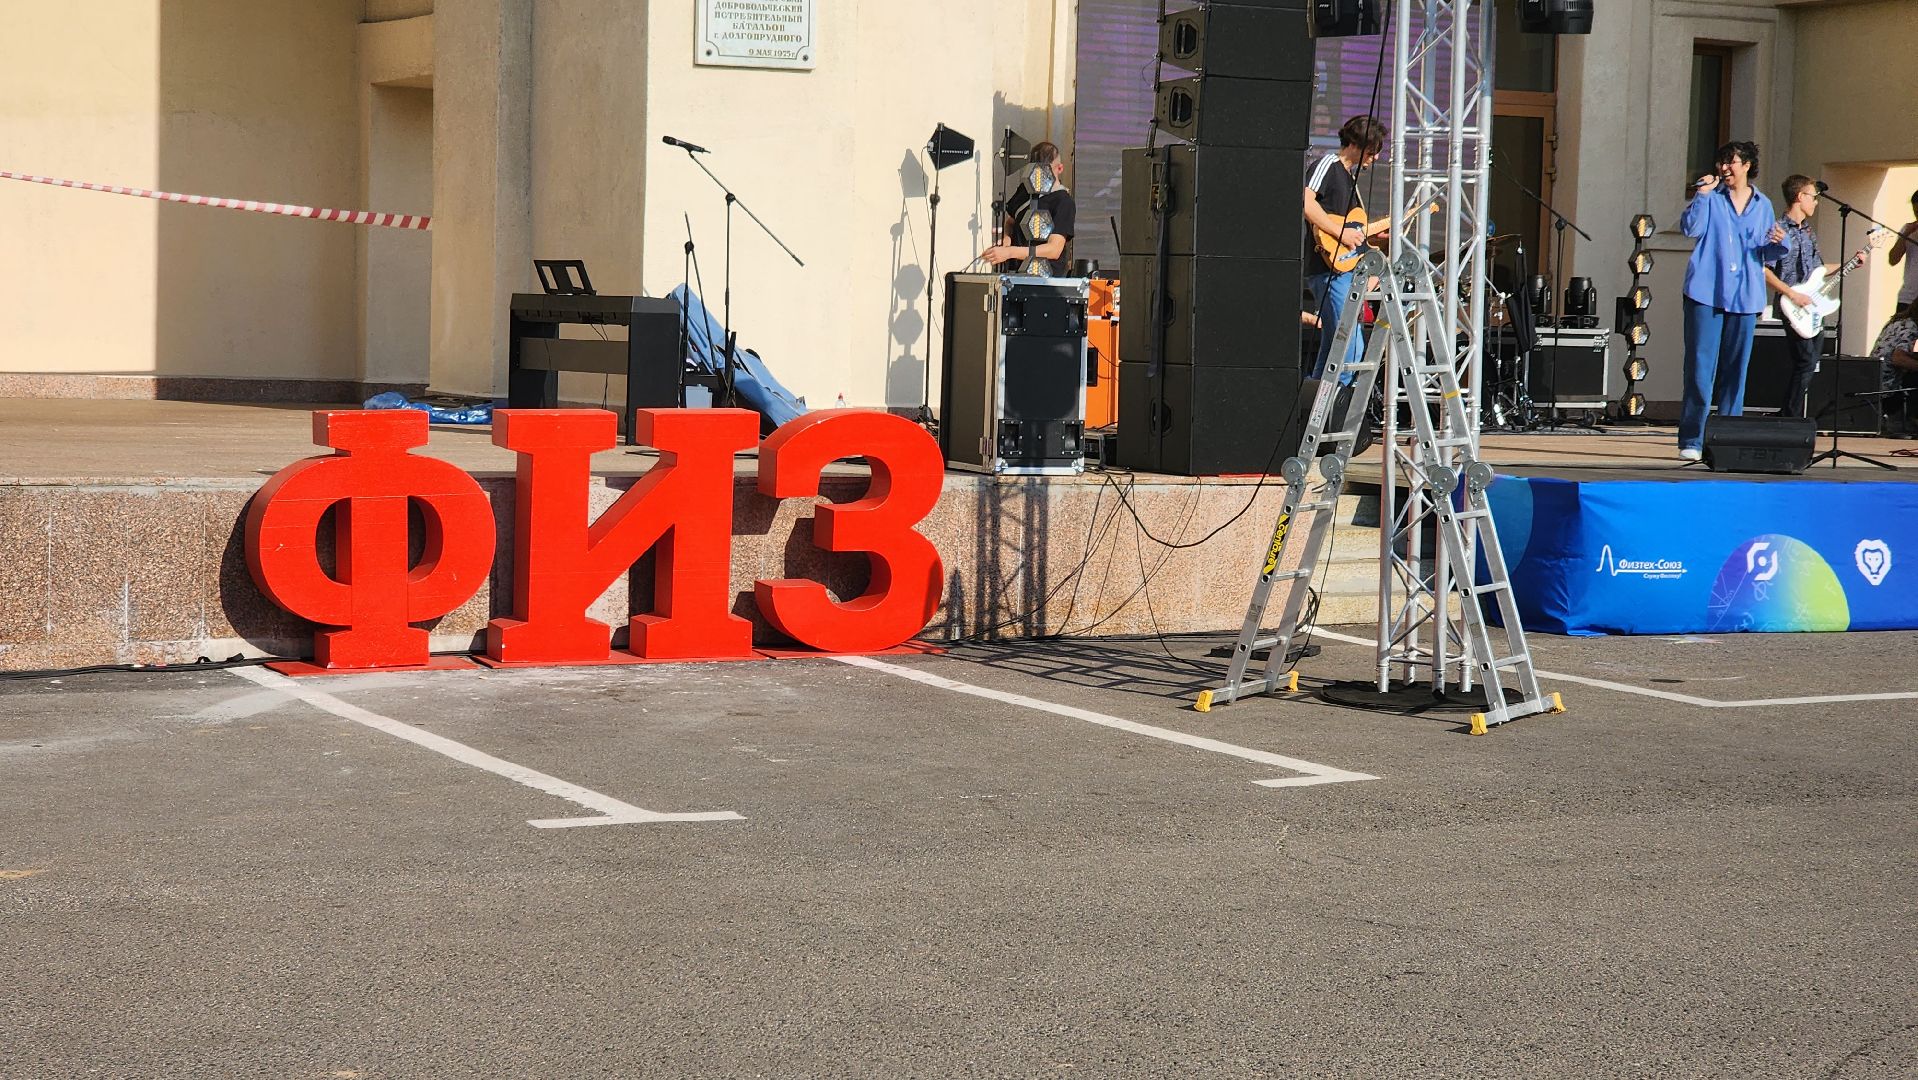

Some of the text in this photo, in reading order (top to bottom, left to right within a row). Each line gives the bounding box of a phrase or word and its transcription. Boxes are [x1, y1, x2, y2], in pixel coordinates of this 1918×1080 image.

[732, 22, 785, 32] БАТАЛЬОН
[721, 32, 803, 43] ДОЛГОПРУДНОГО
[748, 48, 754, 56] 9
[756, 49, 772, 57] МАЯ
[245, 407, 945, 669] ФИЗ
[1619, 559, 1683, 569] Физтех-Союз
